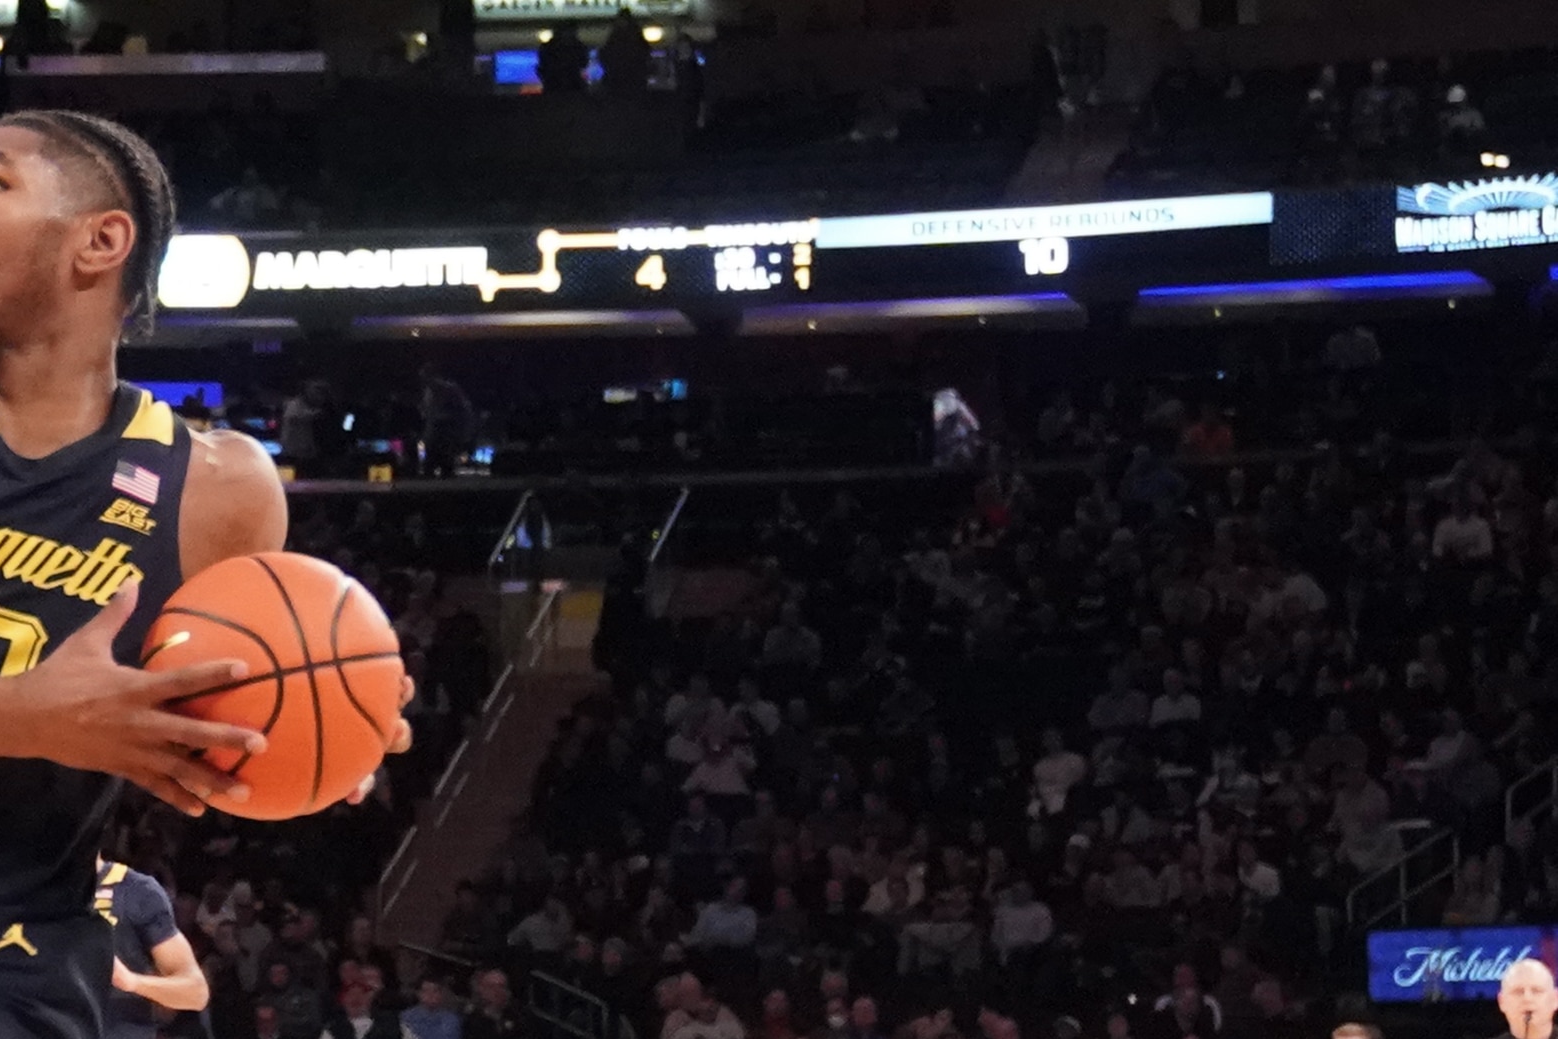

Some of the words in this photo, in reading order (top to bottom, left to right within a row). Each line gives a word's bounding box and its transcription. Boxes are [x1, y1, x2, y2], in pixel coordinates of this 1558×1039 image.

[911, 216, 1037, 237] DEFENSIVE
[1018, 236, 1069, 275] 10
[635, 254, 667, 290] 4
[102, 507, 158, 533] EAST
[111, 497, 150, 517] BIG
